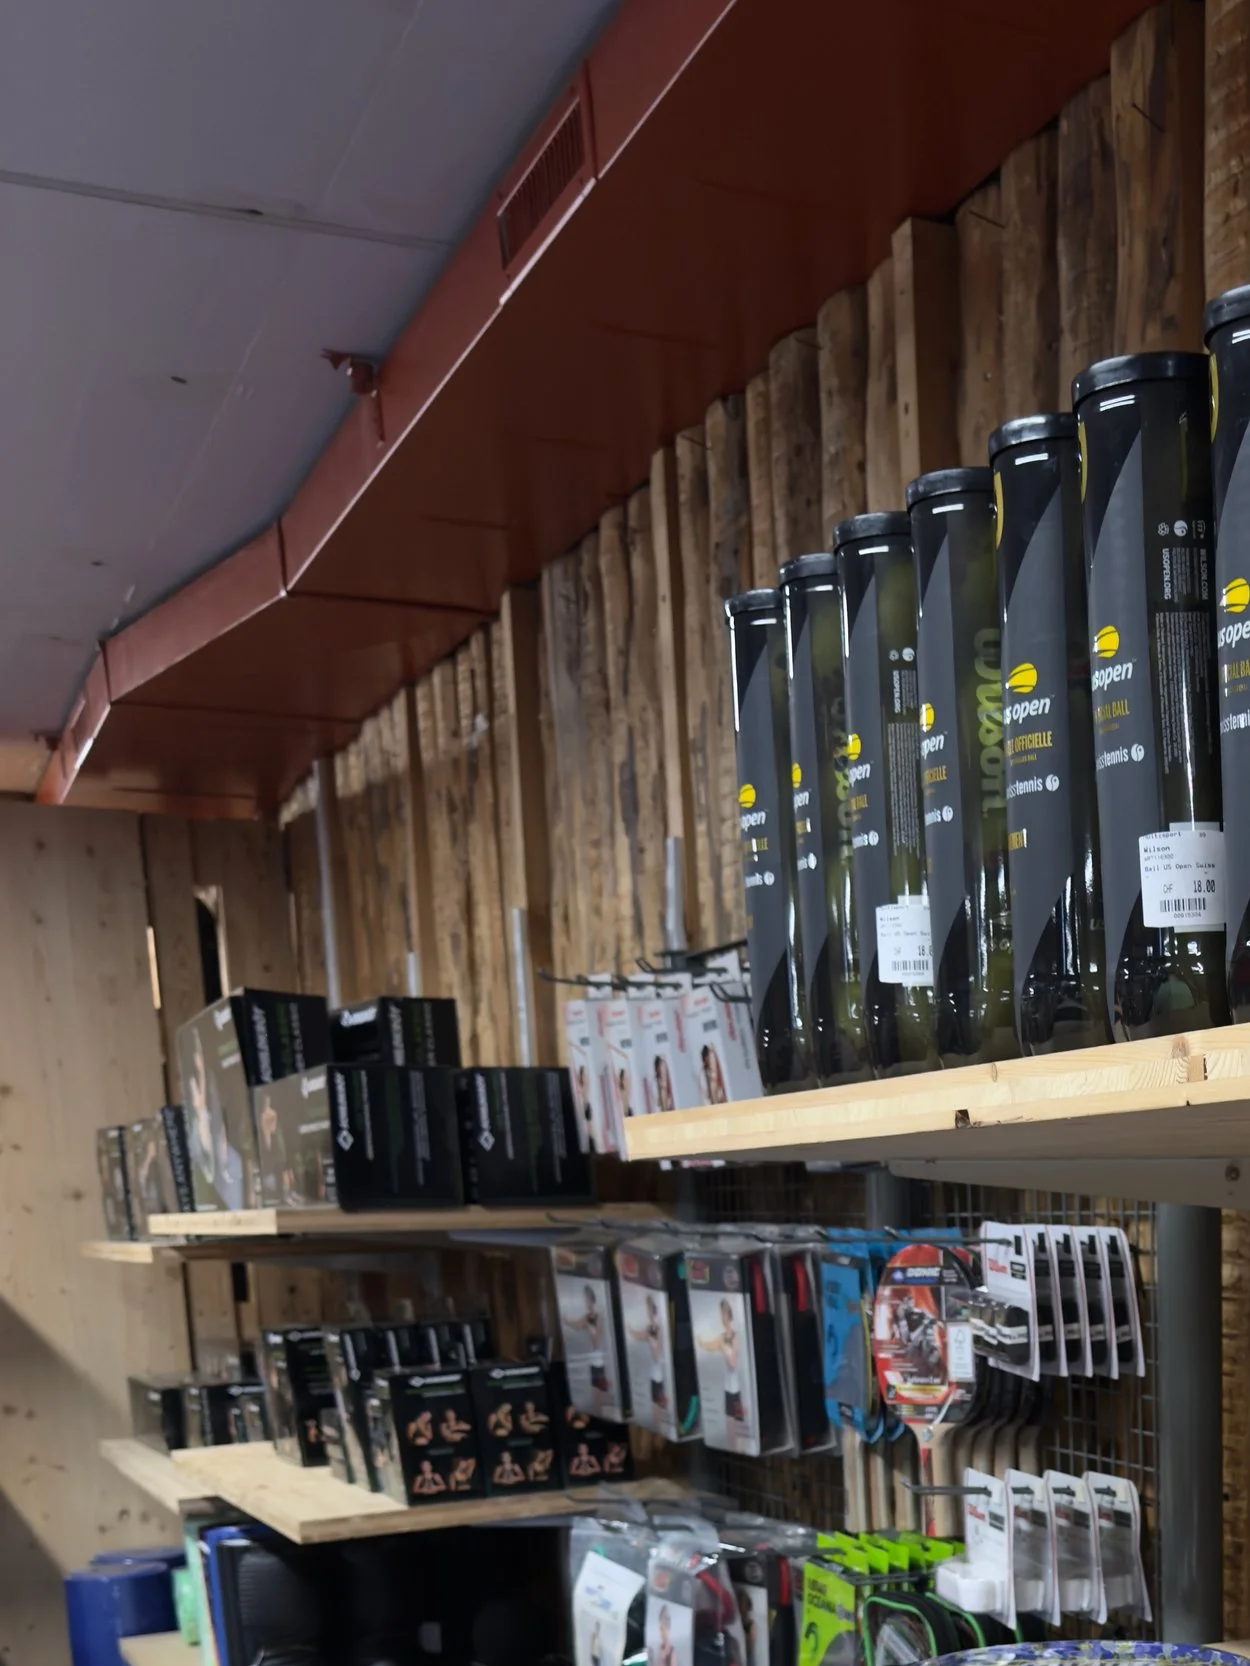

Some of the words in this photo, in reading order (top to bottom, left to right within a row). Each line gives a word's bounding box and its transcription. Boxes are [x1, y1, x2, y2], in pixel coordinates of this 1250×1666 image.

[1162, 548, 1172, 600] USOPEN.ORG
[1100, 662, 1133, 692] open
[1012, 697, 1051, 724] open
[1112, 699, 1130, 716] BALL
